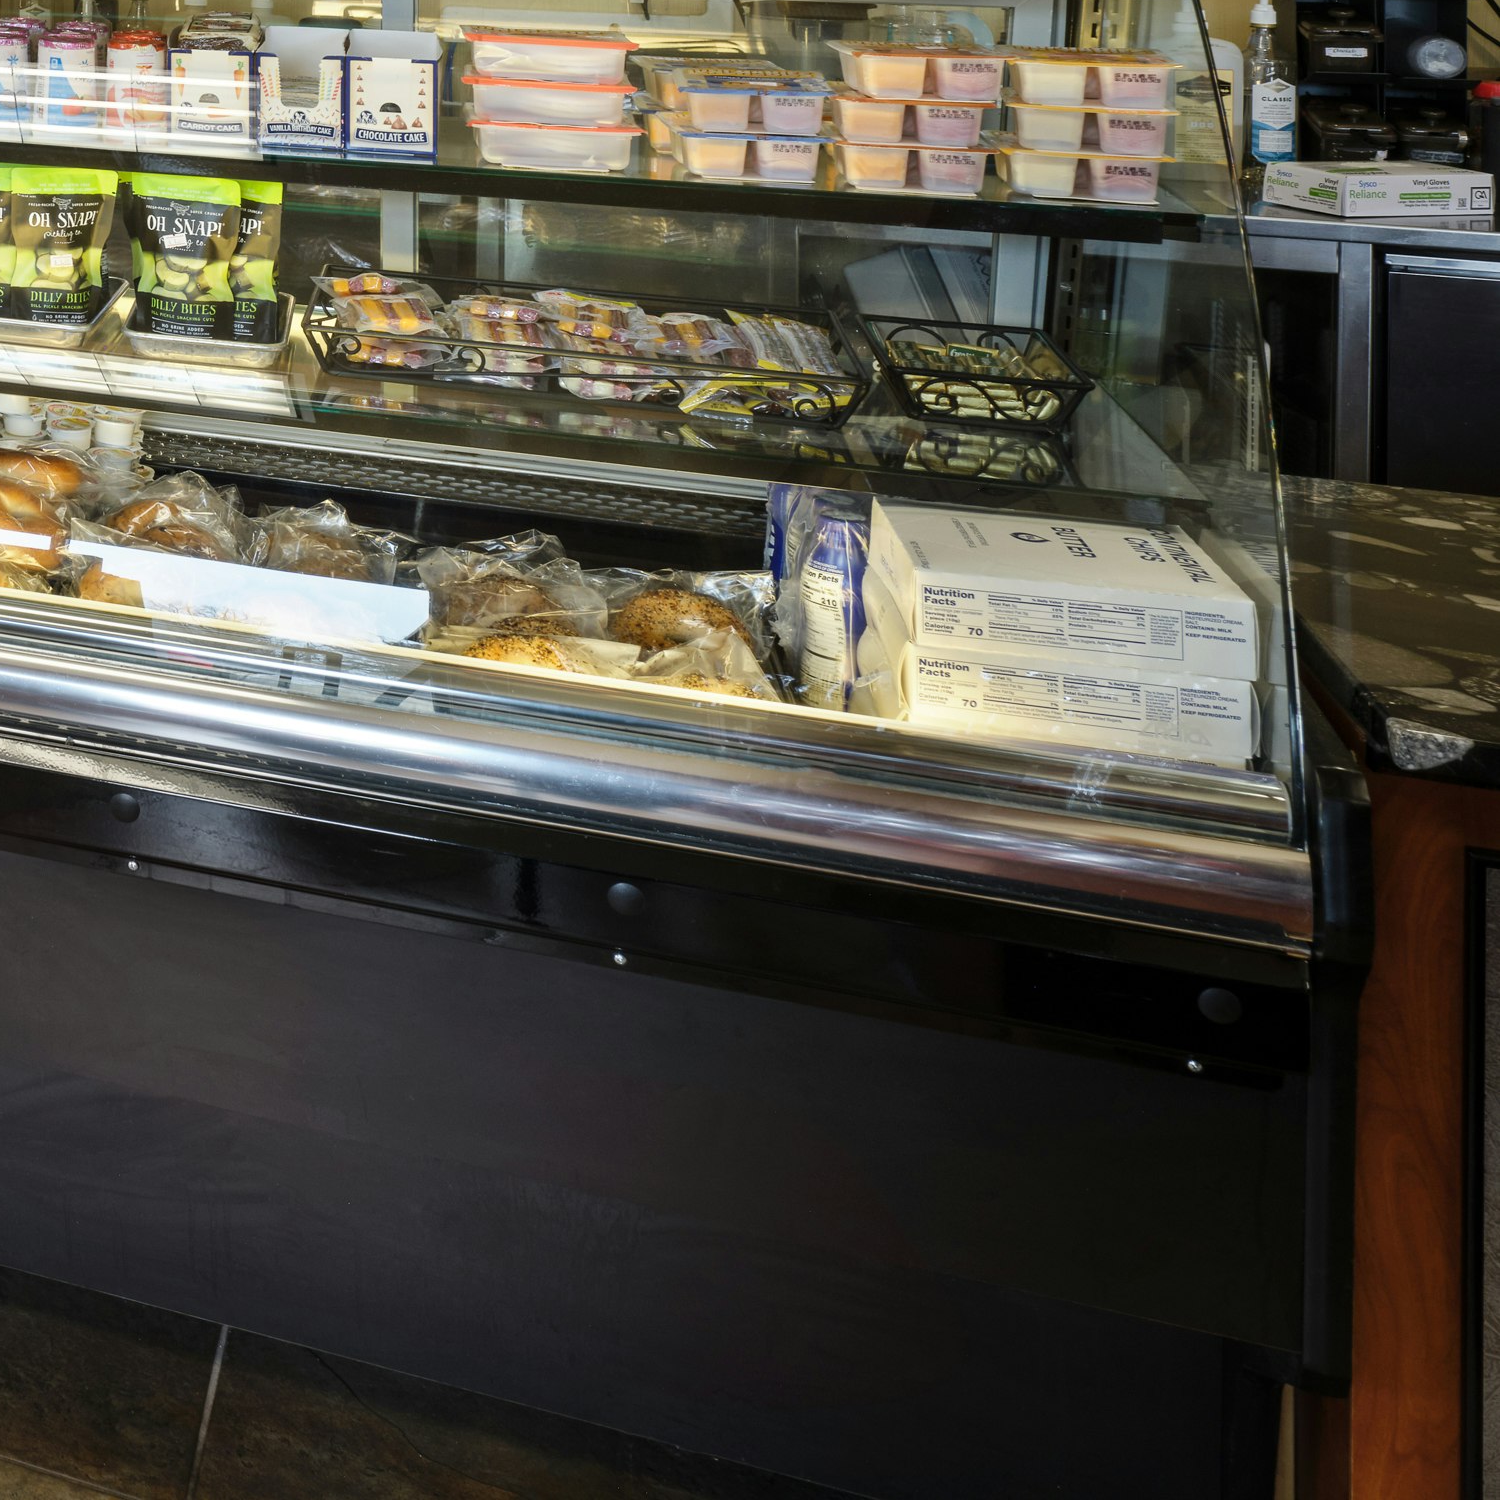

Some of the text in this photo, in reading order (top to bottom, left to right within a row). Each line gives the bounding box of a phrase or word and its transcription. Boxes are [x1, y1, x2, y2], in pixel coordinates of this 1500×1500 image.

[180, 121, 241, 132] CARROT CAKE
[269, 124, 332, 136] VANILLA BIRTHDAY CAKE
[358, 130, 426, 143] CHOCOLATE CAKE
[1276, 169, 1293, 178] Sysco
[1267, 176, 1299, 188] Reliance
[1319, 183, 1337, 191] Gloves
[1359, 180, 1377, 188] Sysco
[1350, 189, 1387, 199] Reliance
[29, 211, 95, 229] OH SNAP!
[147, 215, 222, 238] OH SNAP!
[31, 291, 63, 302] DILLY
[151, 297, 217, 315] DILLY BITES
[1050, 526, 1097, 559] BUTTER
[1123, 537, 1165, 563] CHIPS
[817, 574, 839, 584] Facts
[924, 587, 975, 599] Nutrition
[821, 598, 837, 607] 210
[924, 596, 956, 606] Facts
[924, 622, 983, 636] Calories 70
[1202, 635, 1246, 643] REFRIGERATED
[919, 658, 969, 672] Nutrition
[919, 667, 951, 678] Facts
[962, 699, 977, 707] 70
